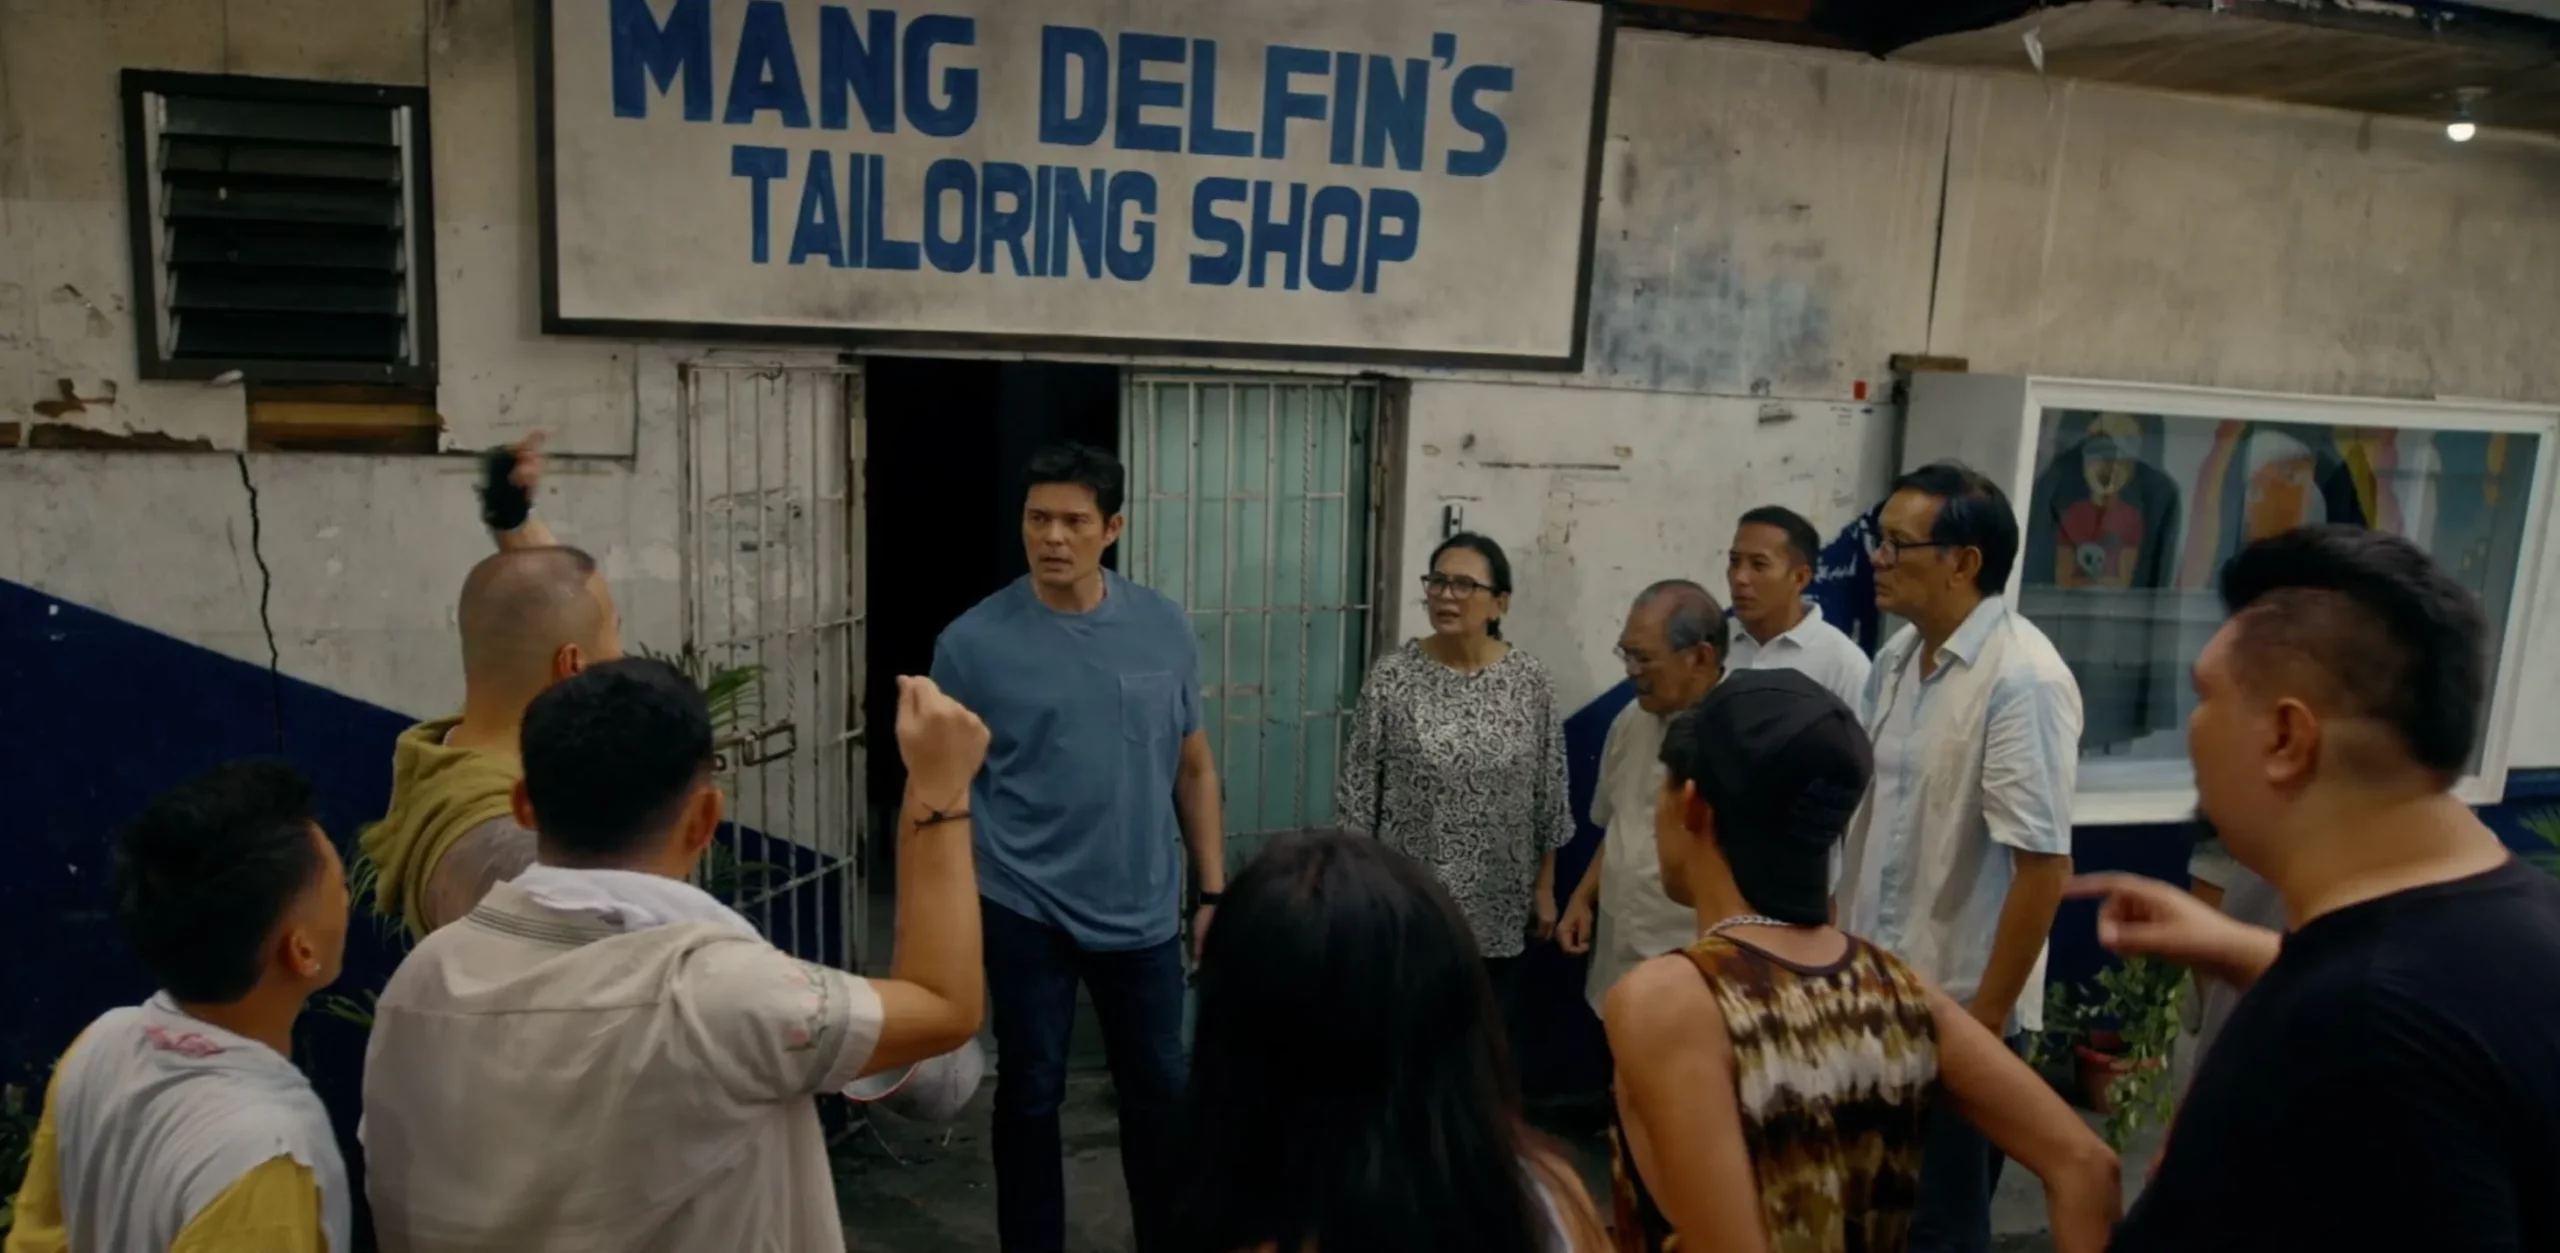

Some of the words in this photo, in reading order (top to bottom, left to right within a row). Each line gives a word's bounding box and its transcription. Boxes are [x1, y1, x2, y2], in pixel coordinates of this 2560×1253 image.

[611, 0, 978, 137] MANG
[1041, 27, 1513, 176] DELFIN'S
[732, 146, 1156, 281] TAILORING
[1190, 177, 1420, 293] SHOP
